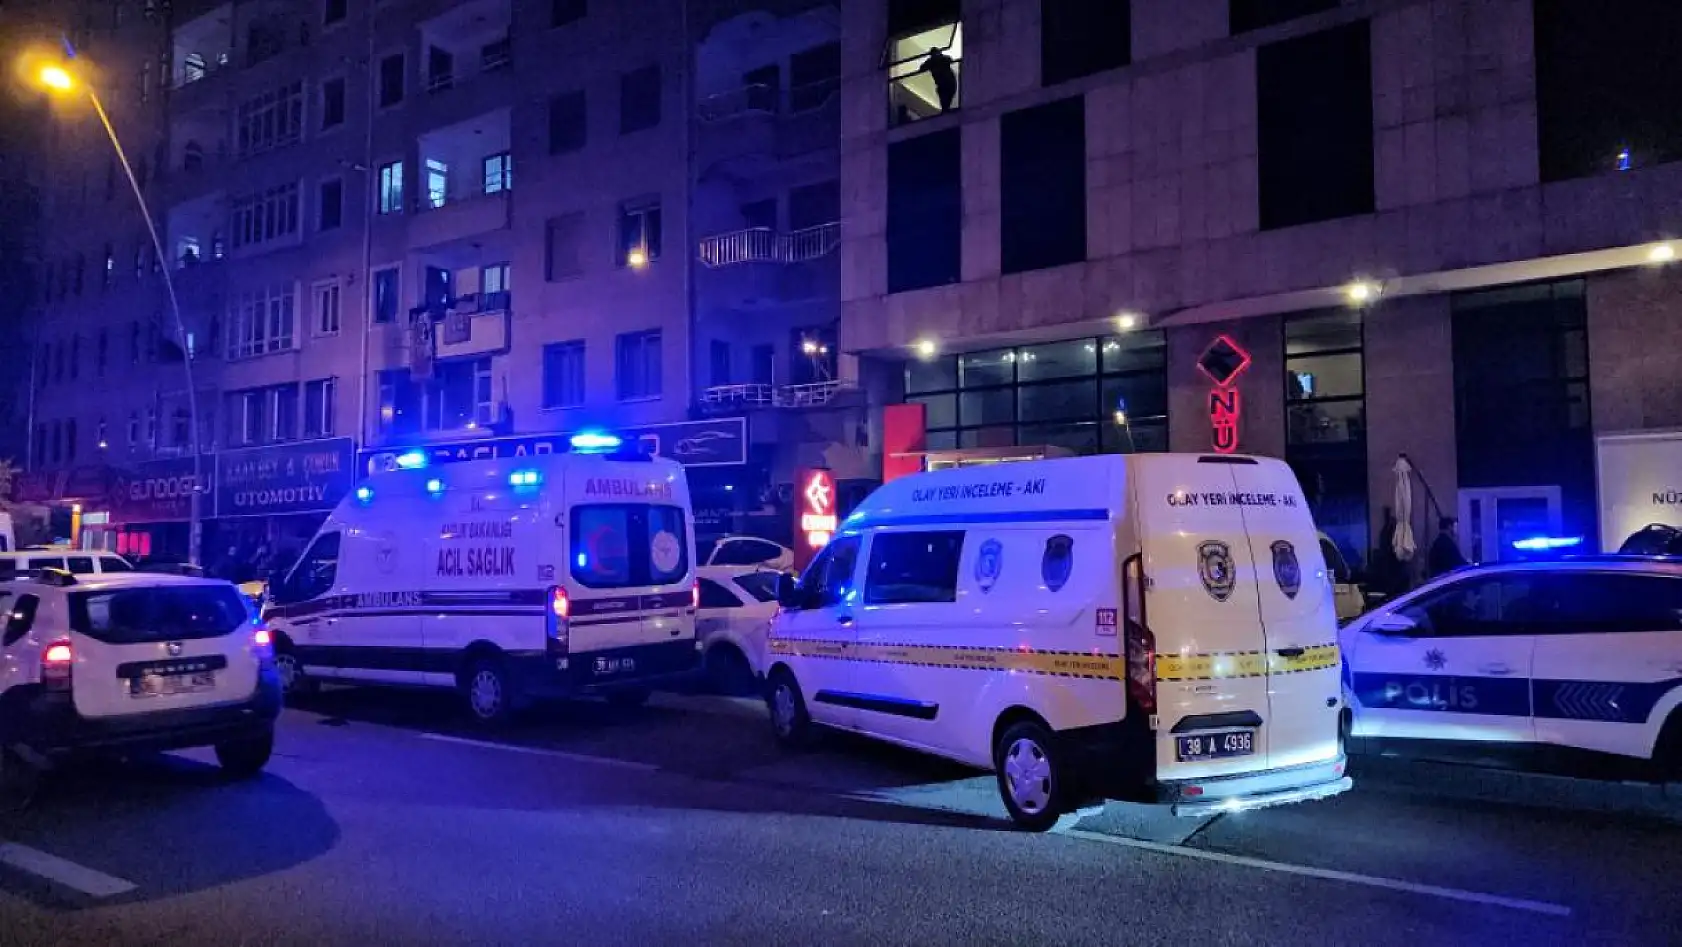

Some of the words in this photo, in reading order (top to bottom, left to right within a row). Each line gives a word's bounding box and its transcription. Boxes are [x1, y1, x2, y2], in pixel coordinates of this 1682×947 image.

[1166, 492, 1198, 506] OLAY
[357, 591, 421, 607] AMBULANS
[1385, 679, 1478, 709] POLİS
[1224, 732, 1252, 751] 4936
